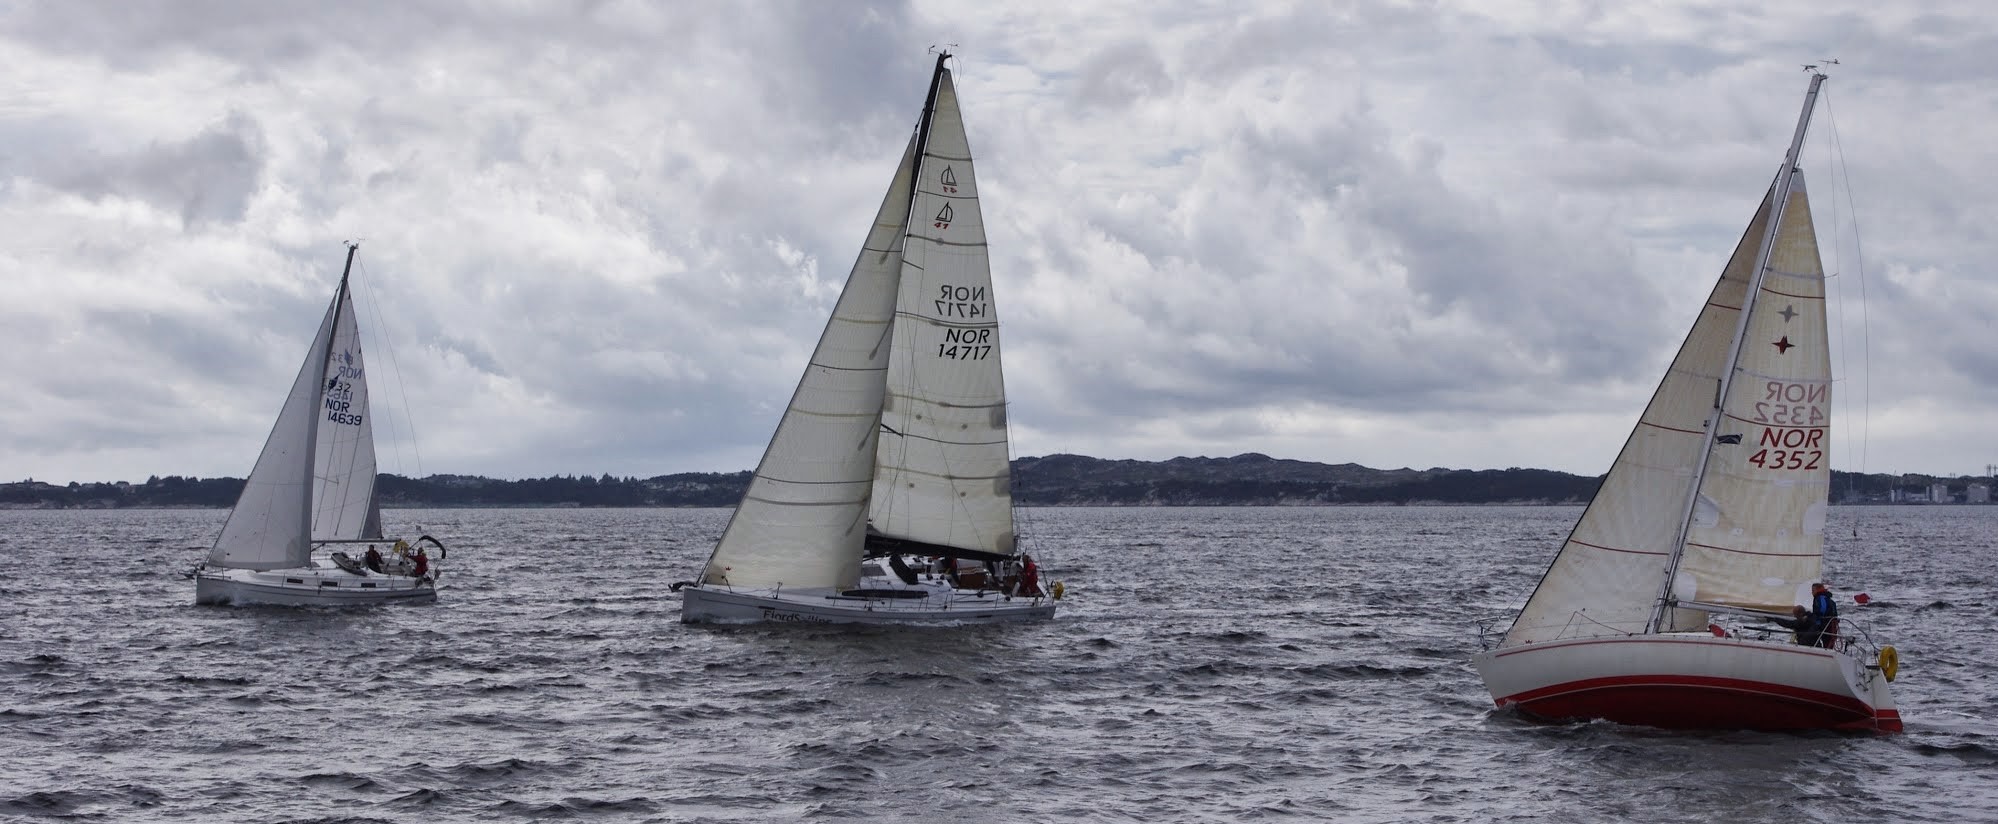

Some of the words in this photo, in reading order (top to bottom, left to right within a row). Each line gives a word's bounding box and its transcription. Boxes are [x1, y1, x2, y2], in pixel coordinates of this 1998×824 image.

[934, 221, 950, 230] 41
[945, 328, 991, 344] NOR
[938, 343, 992, 361] 14717
[337, 382, 351, 393] 32
[325, 398, 350, 414] NOR
[327, 410, 362, 426] 14639
[1759, 427, 1824, 449] NOR
[1748, 449, 1823, 470] 4352
